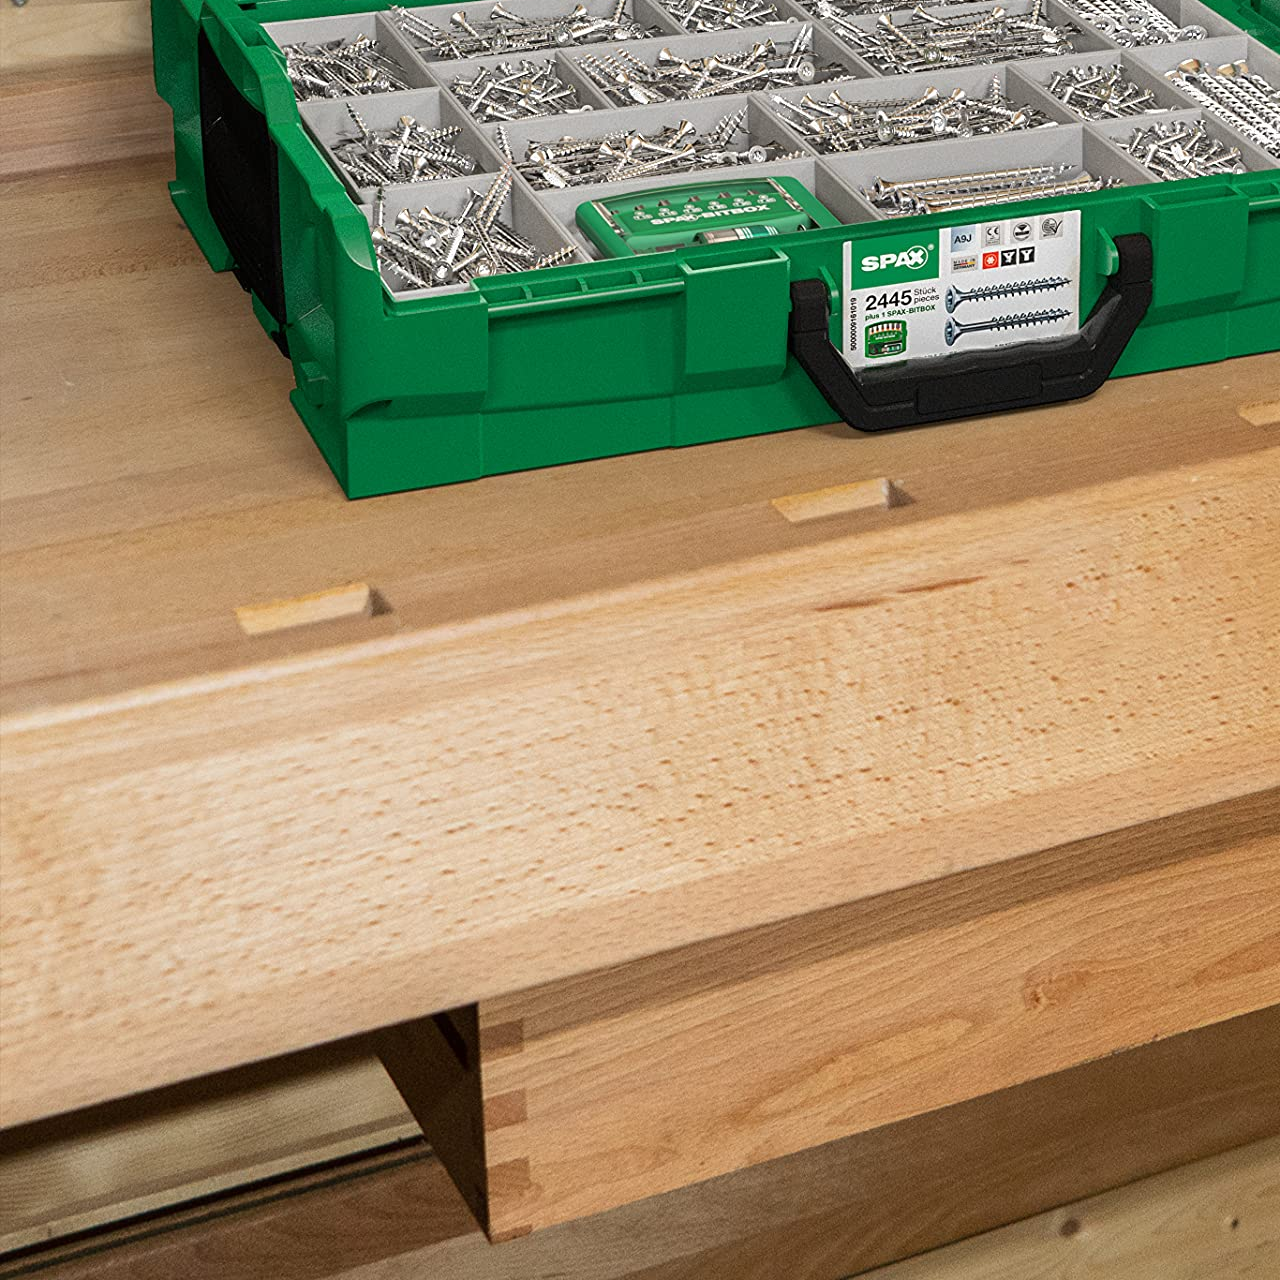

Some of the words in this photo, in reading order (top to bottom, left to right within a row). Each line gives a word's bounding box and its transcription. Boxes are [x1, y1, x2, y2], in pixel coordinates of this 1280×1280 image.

[954, 234, 972, 244] A9J
[861, 248, 925, 272] SPAX
[865, 290, 912, 311] 2445
[913, 287, 937, 296] Stück
[913, 295, 940, 304] pieces
[886, 304, 936, 318] SPAX-BITBOX
